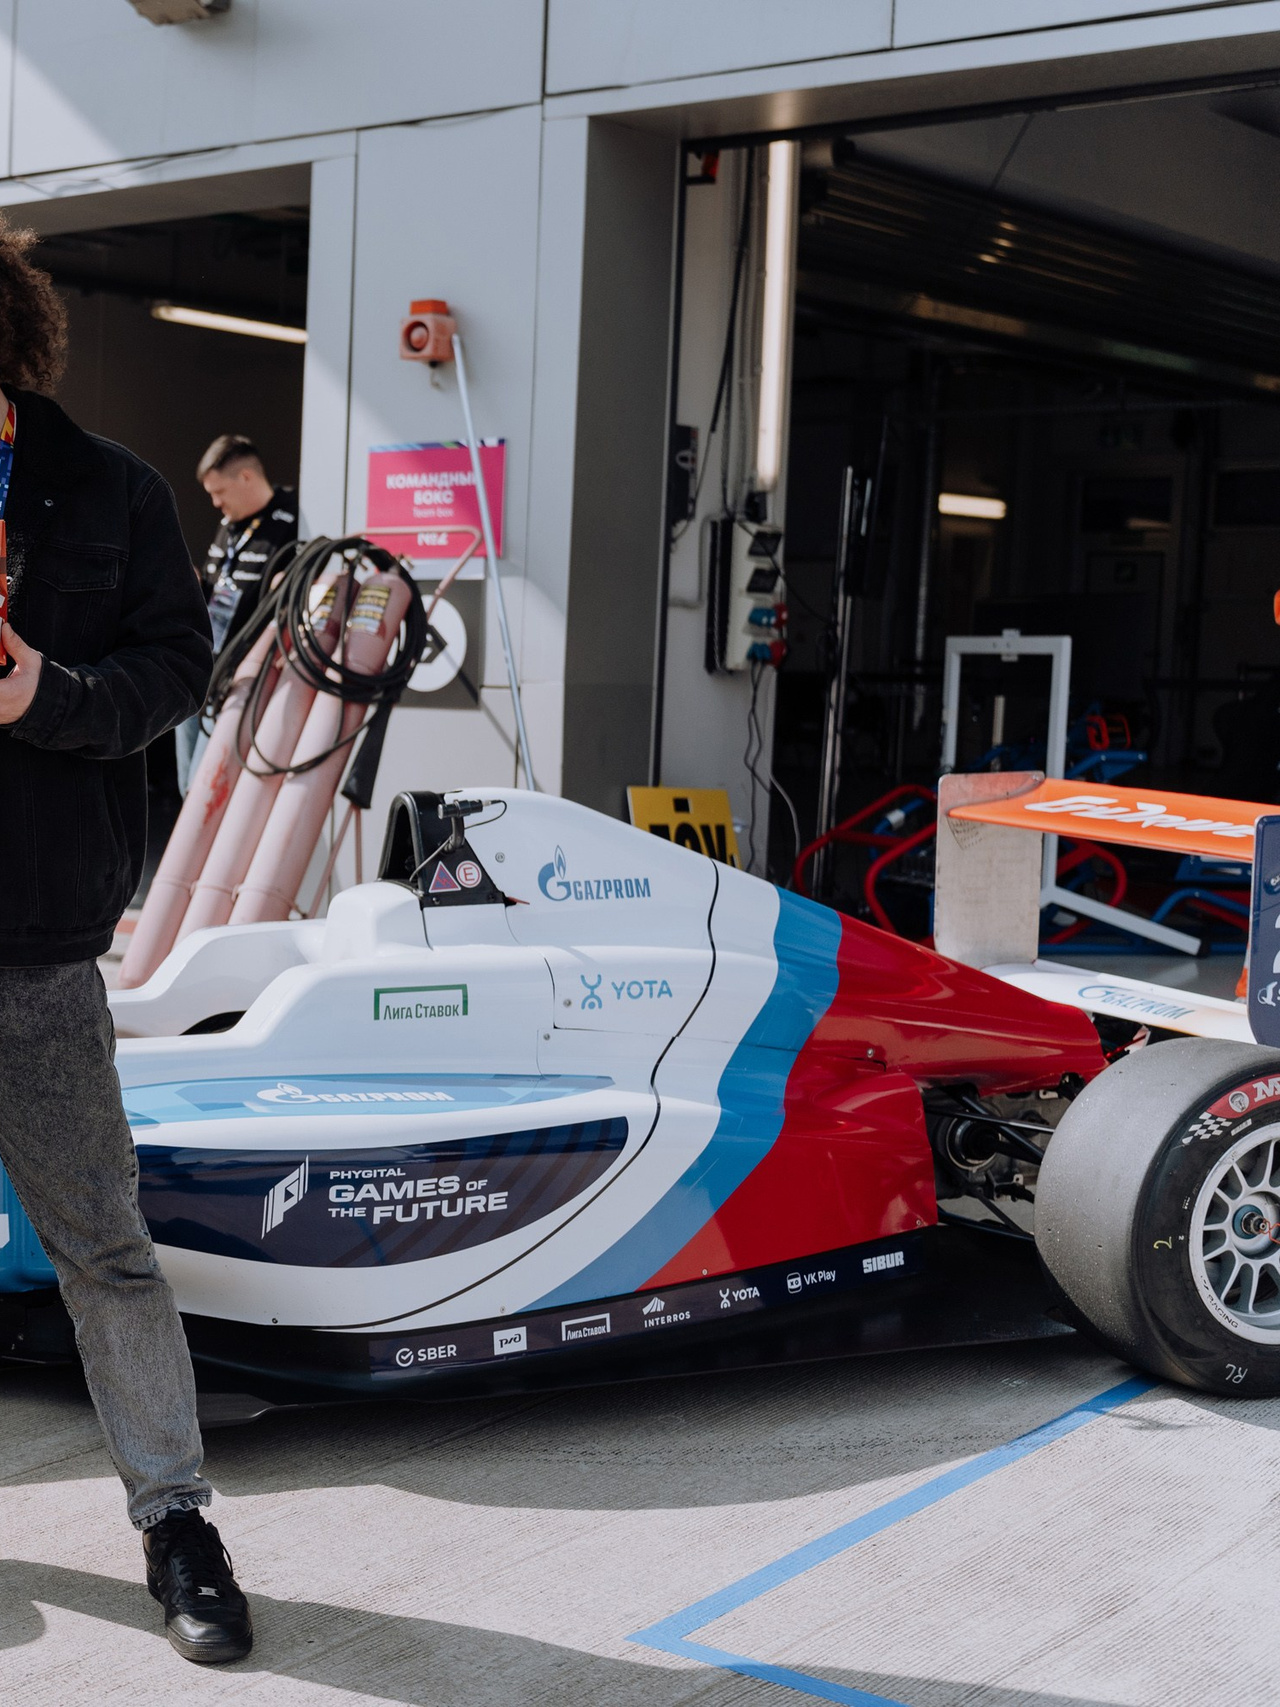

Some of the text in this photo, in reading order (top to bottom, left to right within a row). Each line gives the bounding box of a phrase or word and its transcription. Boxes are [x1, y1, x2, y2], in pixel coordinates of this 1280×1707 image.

[385, 472, 477, 489] КОМАНДНЫ
[413, 490, 454, 505] БОКС
[463, 866, 475, 881] E
[572, 878, 651, 900] GAZPROM
[611, 979, 673, 1000] YOTA
[319, 1091, 456, 1103] GAZPROM
[329, 1168, 406, 1180] PHYGITAL
[328, 1175, 488, 1203] GAMES OF
[328, 1191, 509, 1225] THE FUTURE
[1153, 1235, 1173, 1250] 2
[862, 1251, 905, 1274] SIBUR
[803, 1269, 837, 1286] VK Play
[732, 1286, 761, 1302] YOTA
[644, 1310, 692, 1329] INTERROS
[417, 1343, 458, 1362] SBER
